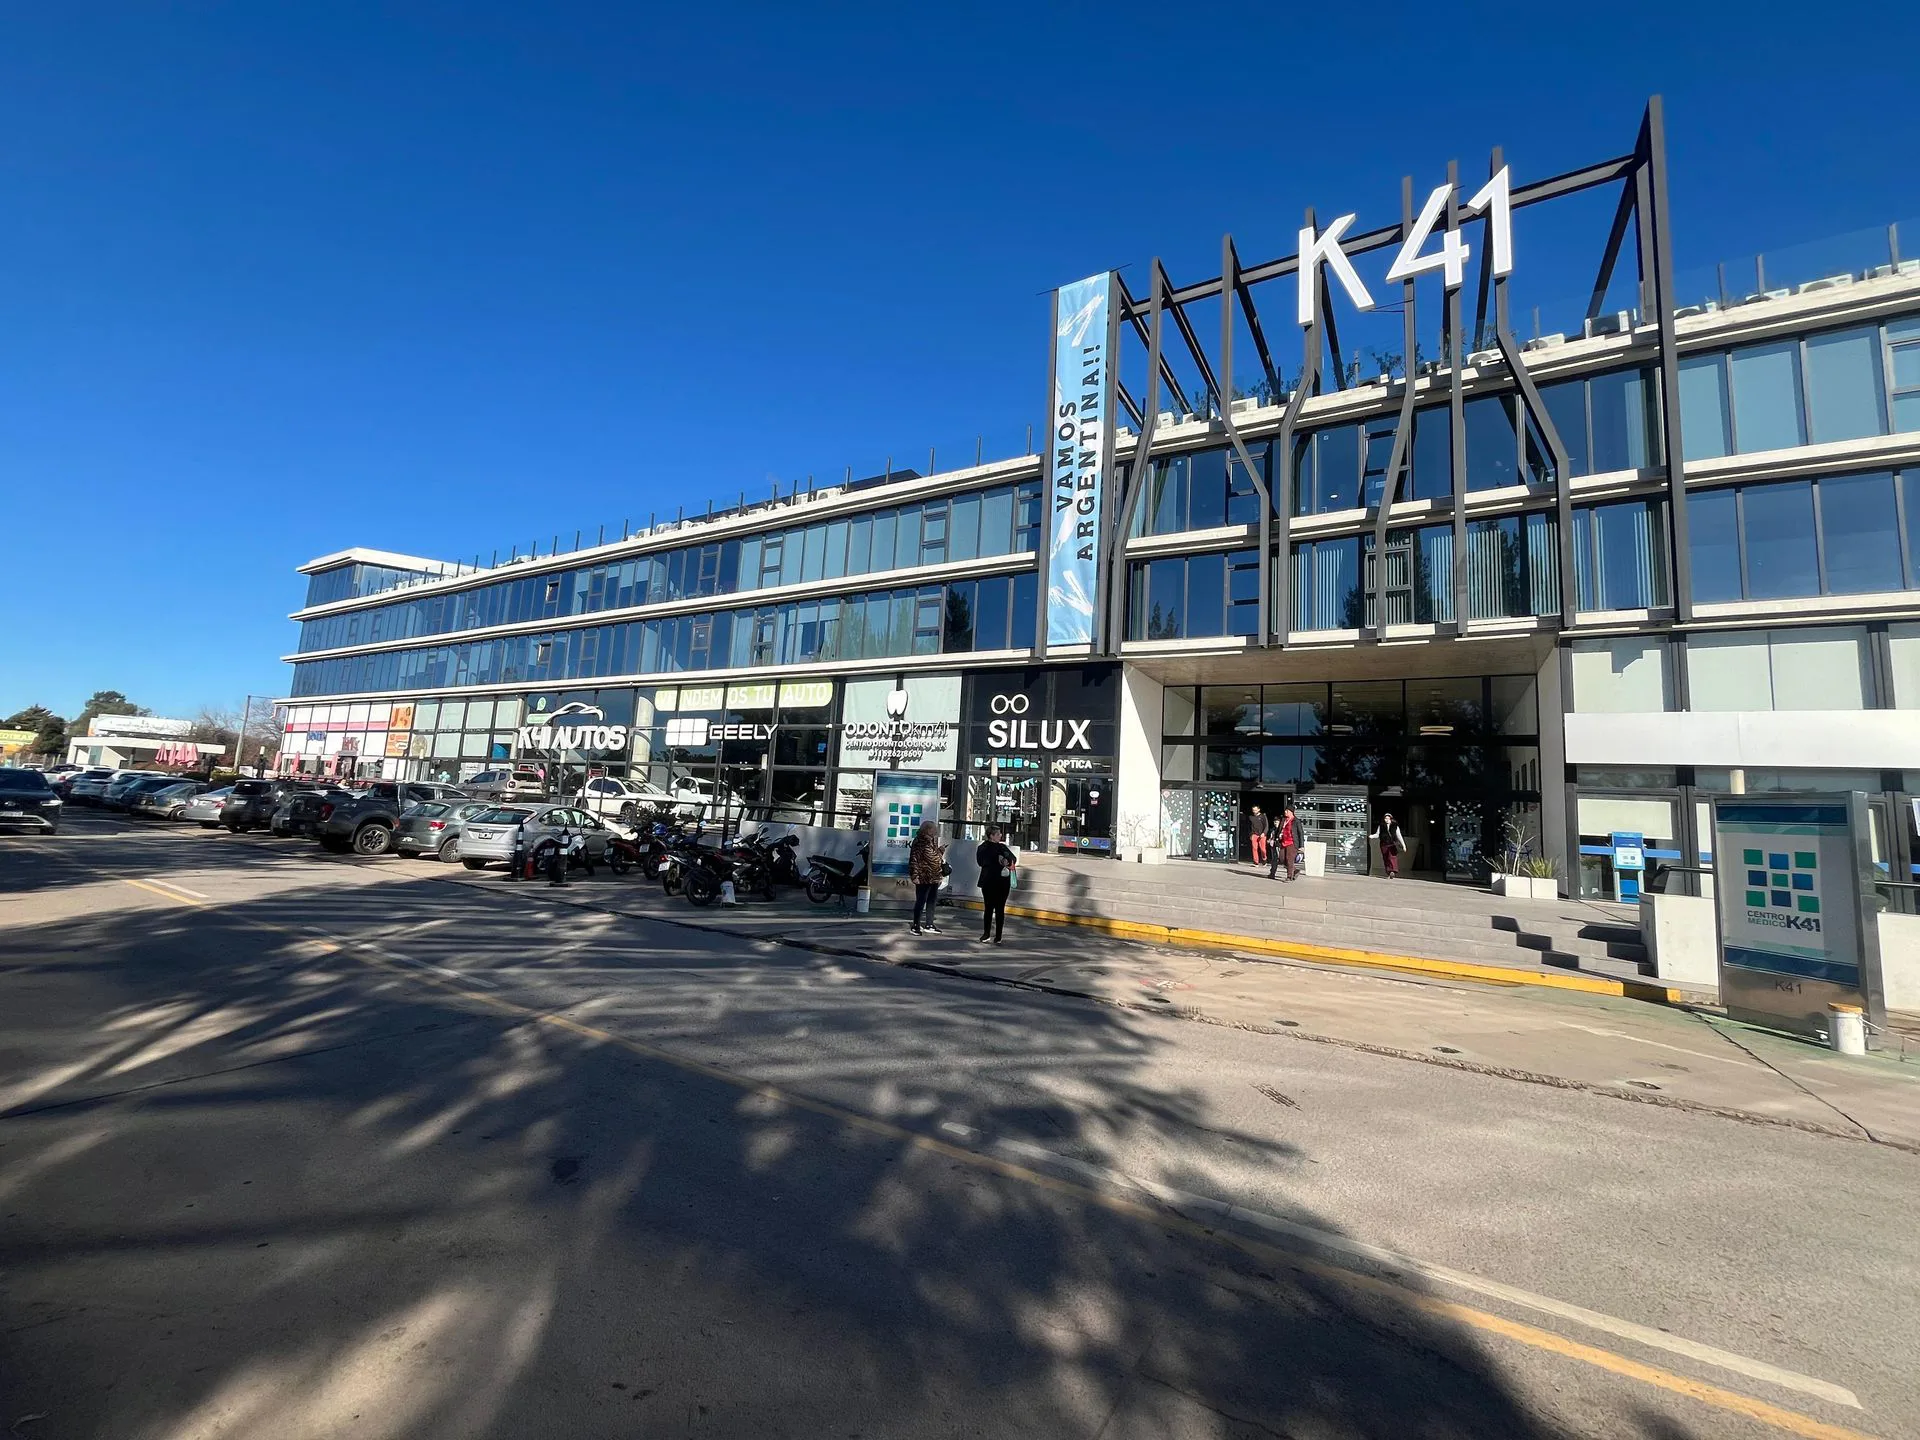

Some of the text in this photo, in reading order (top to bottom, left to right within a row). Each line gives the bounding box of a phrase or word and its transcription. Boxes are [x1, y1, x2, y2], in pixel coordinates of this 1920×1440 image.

[1056, 401, 1077, 513] VAMOS
[1076, 344, 1101, 561] ARGENTINA!!
[755, 686, 775, 704] TU
[783, 682, 827, 702] AUTO
[551, 725, 627, 751] AUTOS
[709, 723, 779, 740] GEELY
[987, 719, 1091, 749] SILUX
[846, 740, 872, 748] CENTRO
[1056, 759, 1092, 769] OPTICA
[1747, 910, 1785, 921] CENTRO
[1786, 914, 1821, 933] K41
[1775, 980, 1802, 995] K41
